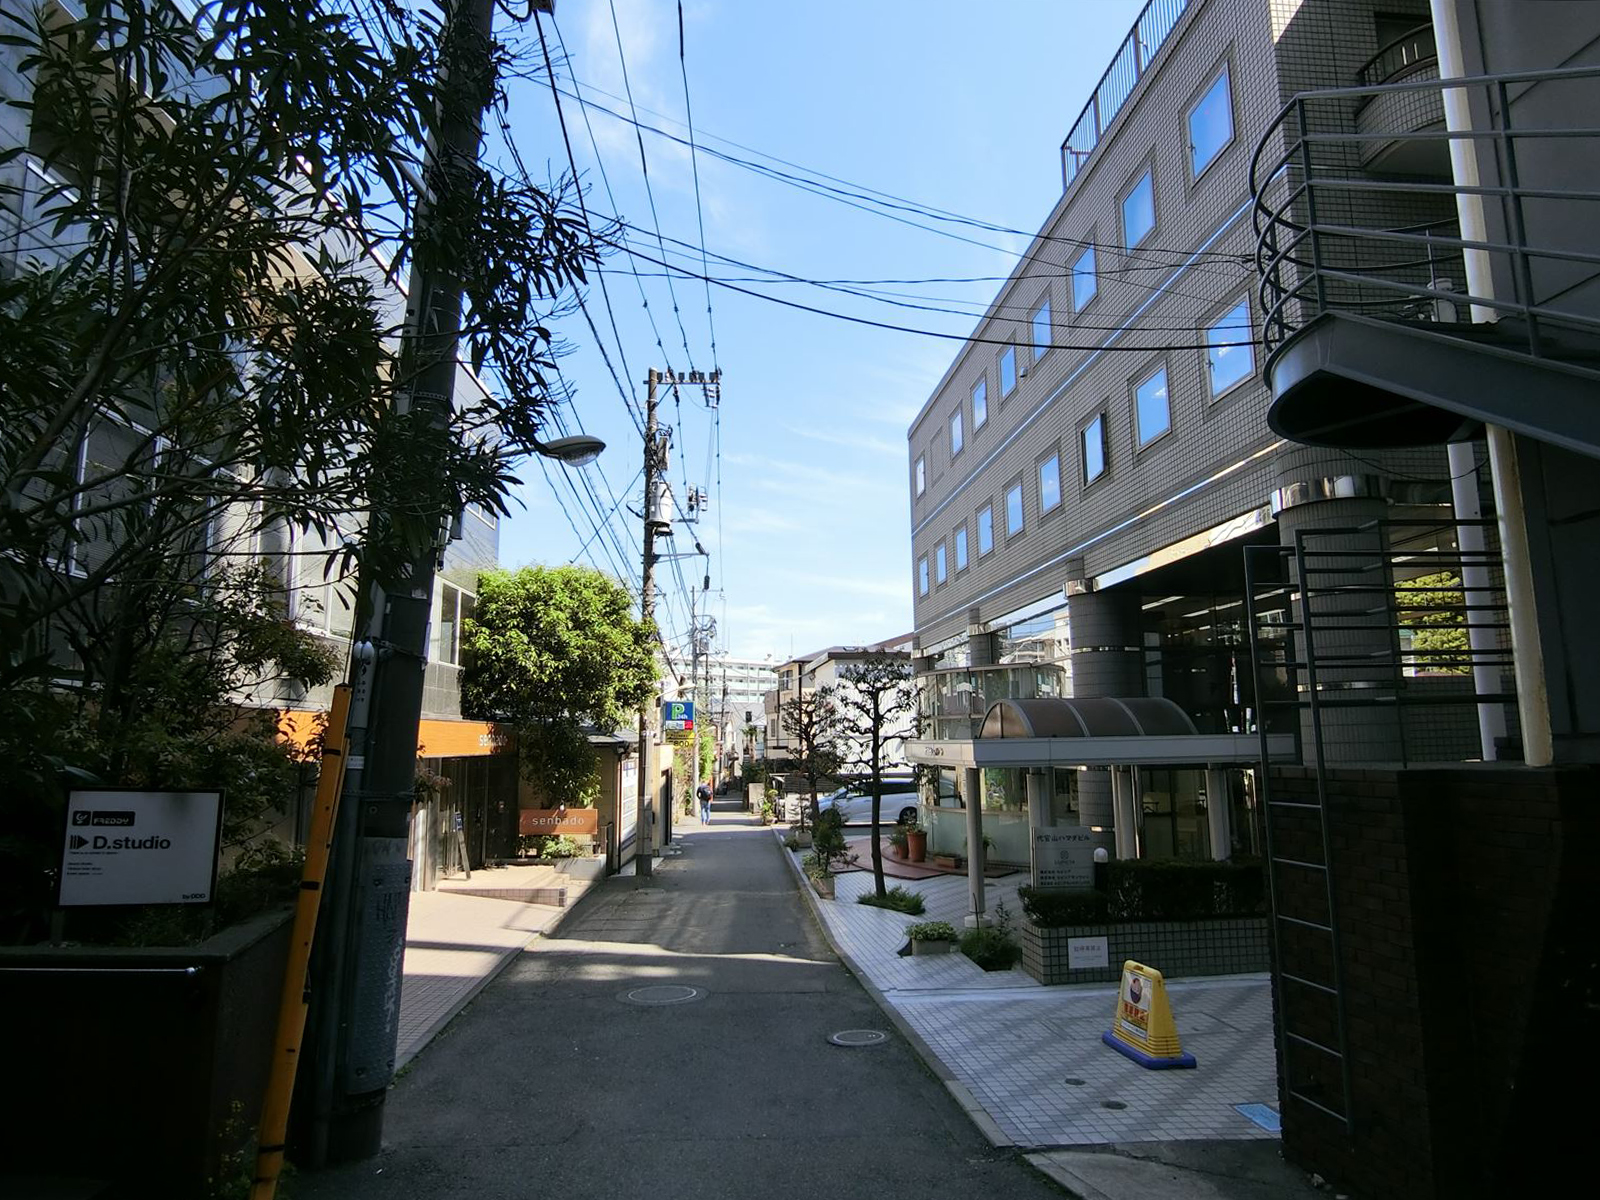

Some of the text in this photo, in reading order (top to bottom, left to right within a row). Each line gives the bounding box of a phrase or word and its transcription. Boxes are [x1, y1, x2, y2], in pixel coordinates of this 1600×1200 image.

[671, 703, 685, 720] P
[93, 817, 129, 825] FREDDY
[532, 815, 585, 825] senbado
[92, 835, 171, 850] D.studio
